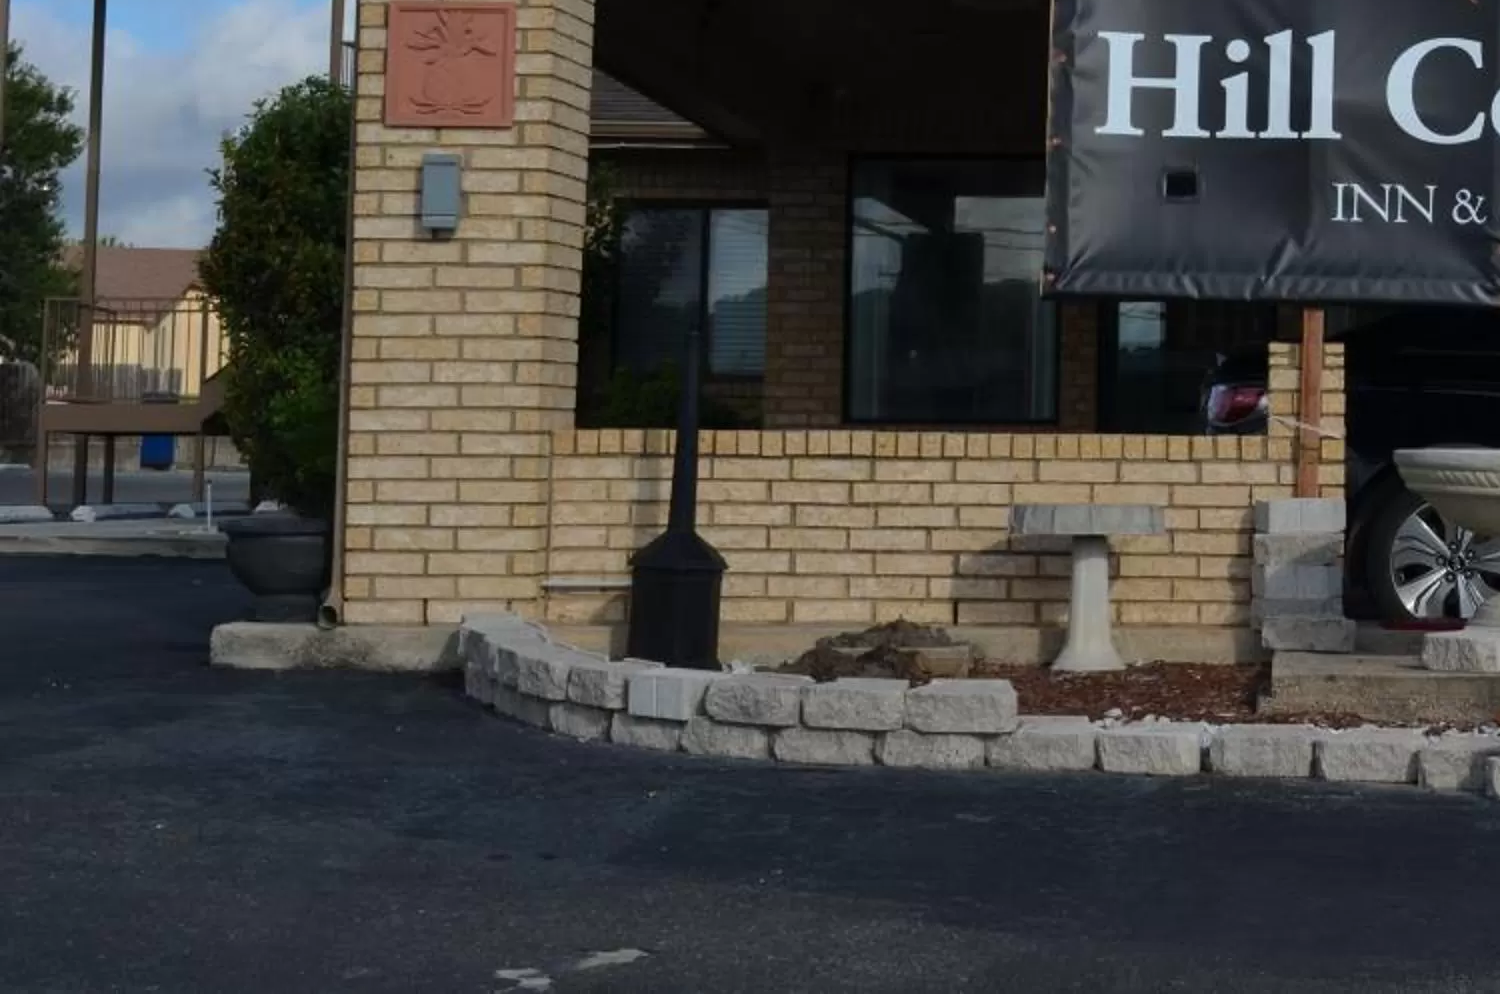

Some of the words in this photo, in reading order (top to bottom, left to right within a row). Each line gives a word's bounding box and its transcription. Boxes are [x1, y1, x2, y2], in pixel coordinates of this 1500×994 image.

[1094, 29, 1342, 139] Hill
[1331, 182, 1437, 223] INN
[1451, 188, 1487, 225] &
